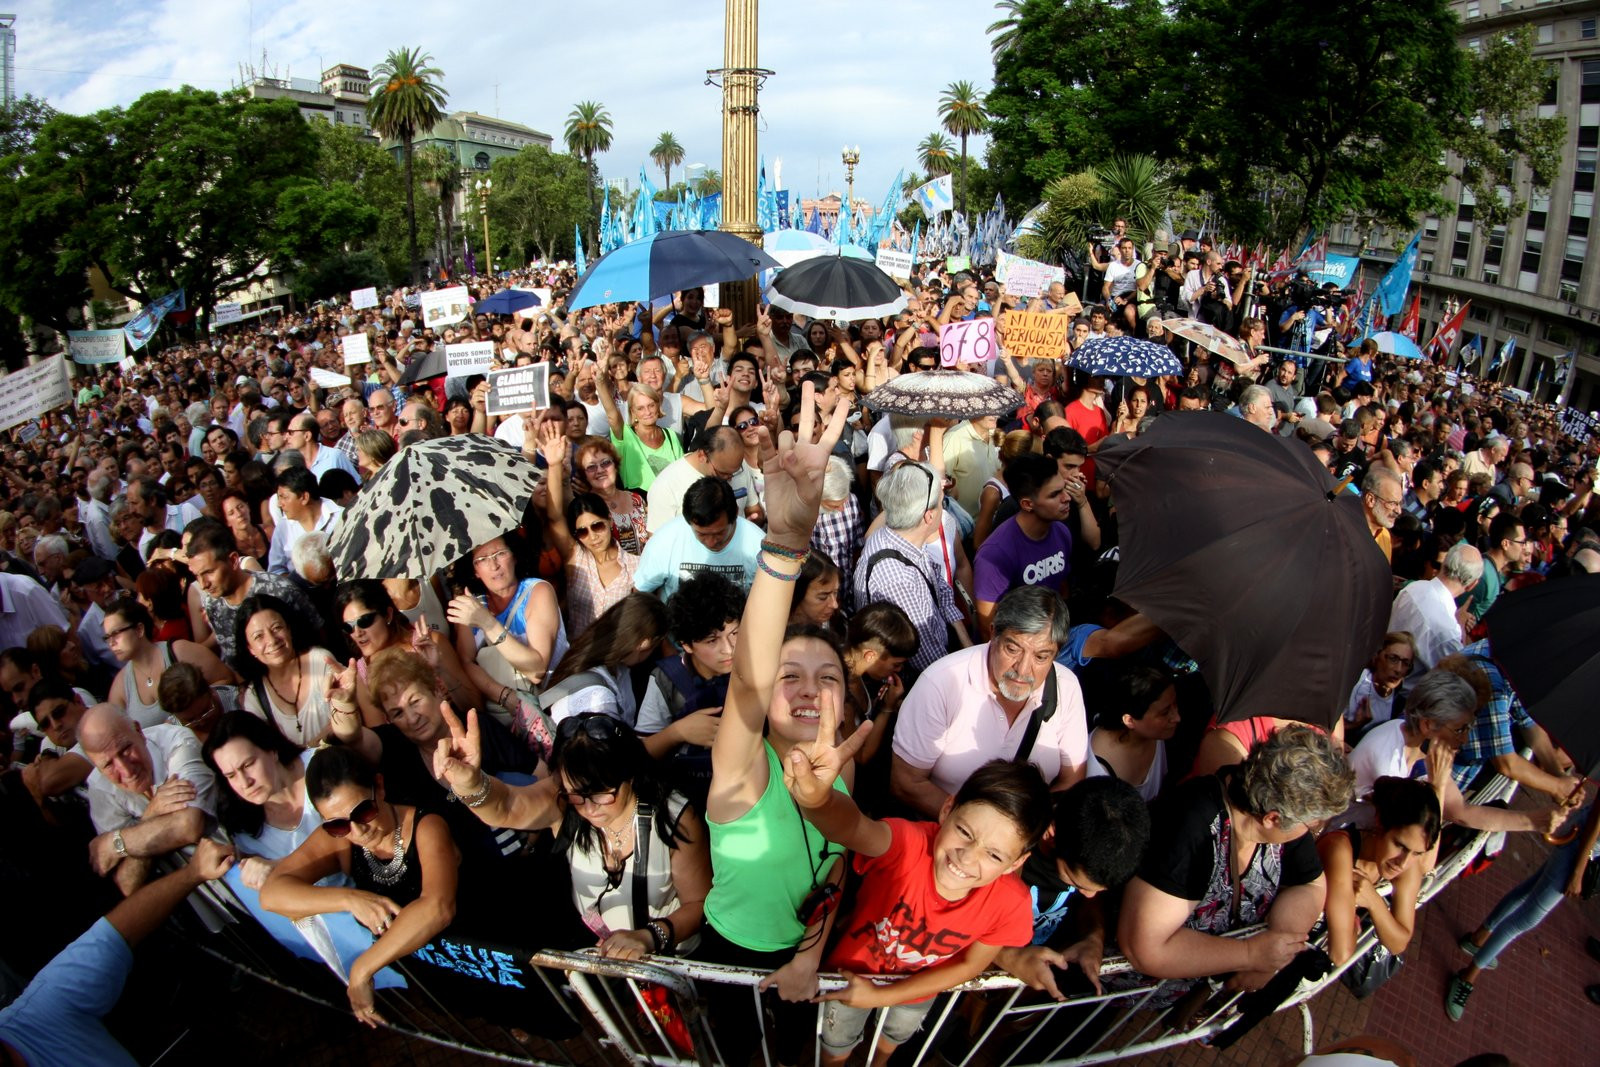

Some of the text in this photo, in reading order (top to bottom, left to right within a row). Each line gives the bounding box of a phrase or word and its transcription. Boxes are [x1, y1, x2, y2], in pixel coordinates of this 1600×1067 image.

[896, 262, 910, 270] HUGO
[1568, 306, 1582, 319] LA
[1010, 313, 1027, 327] NI
[941, 321, 991, 362] 678
[1004, 327, 1065, 347] PERIODISTA
[448, 350, 469, 358] TODOS
[1005, 343, 1055, 357] MENOS
[448, 356, 492, 366] VICTOR HUGO
[496, 383, 534, 397] MANIPULA
[1567, 406, 1596, 427] TODAS
[1571, 417, 1586, 431] LAS
[1559, 420, 1591, 446] VOCES
[1023, 551, 1065, 585] OSIRIS
[441, 938, 523, 975] FUE
